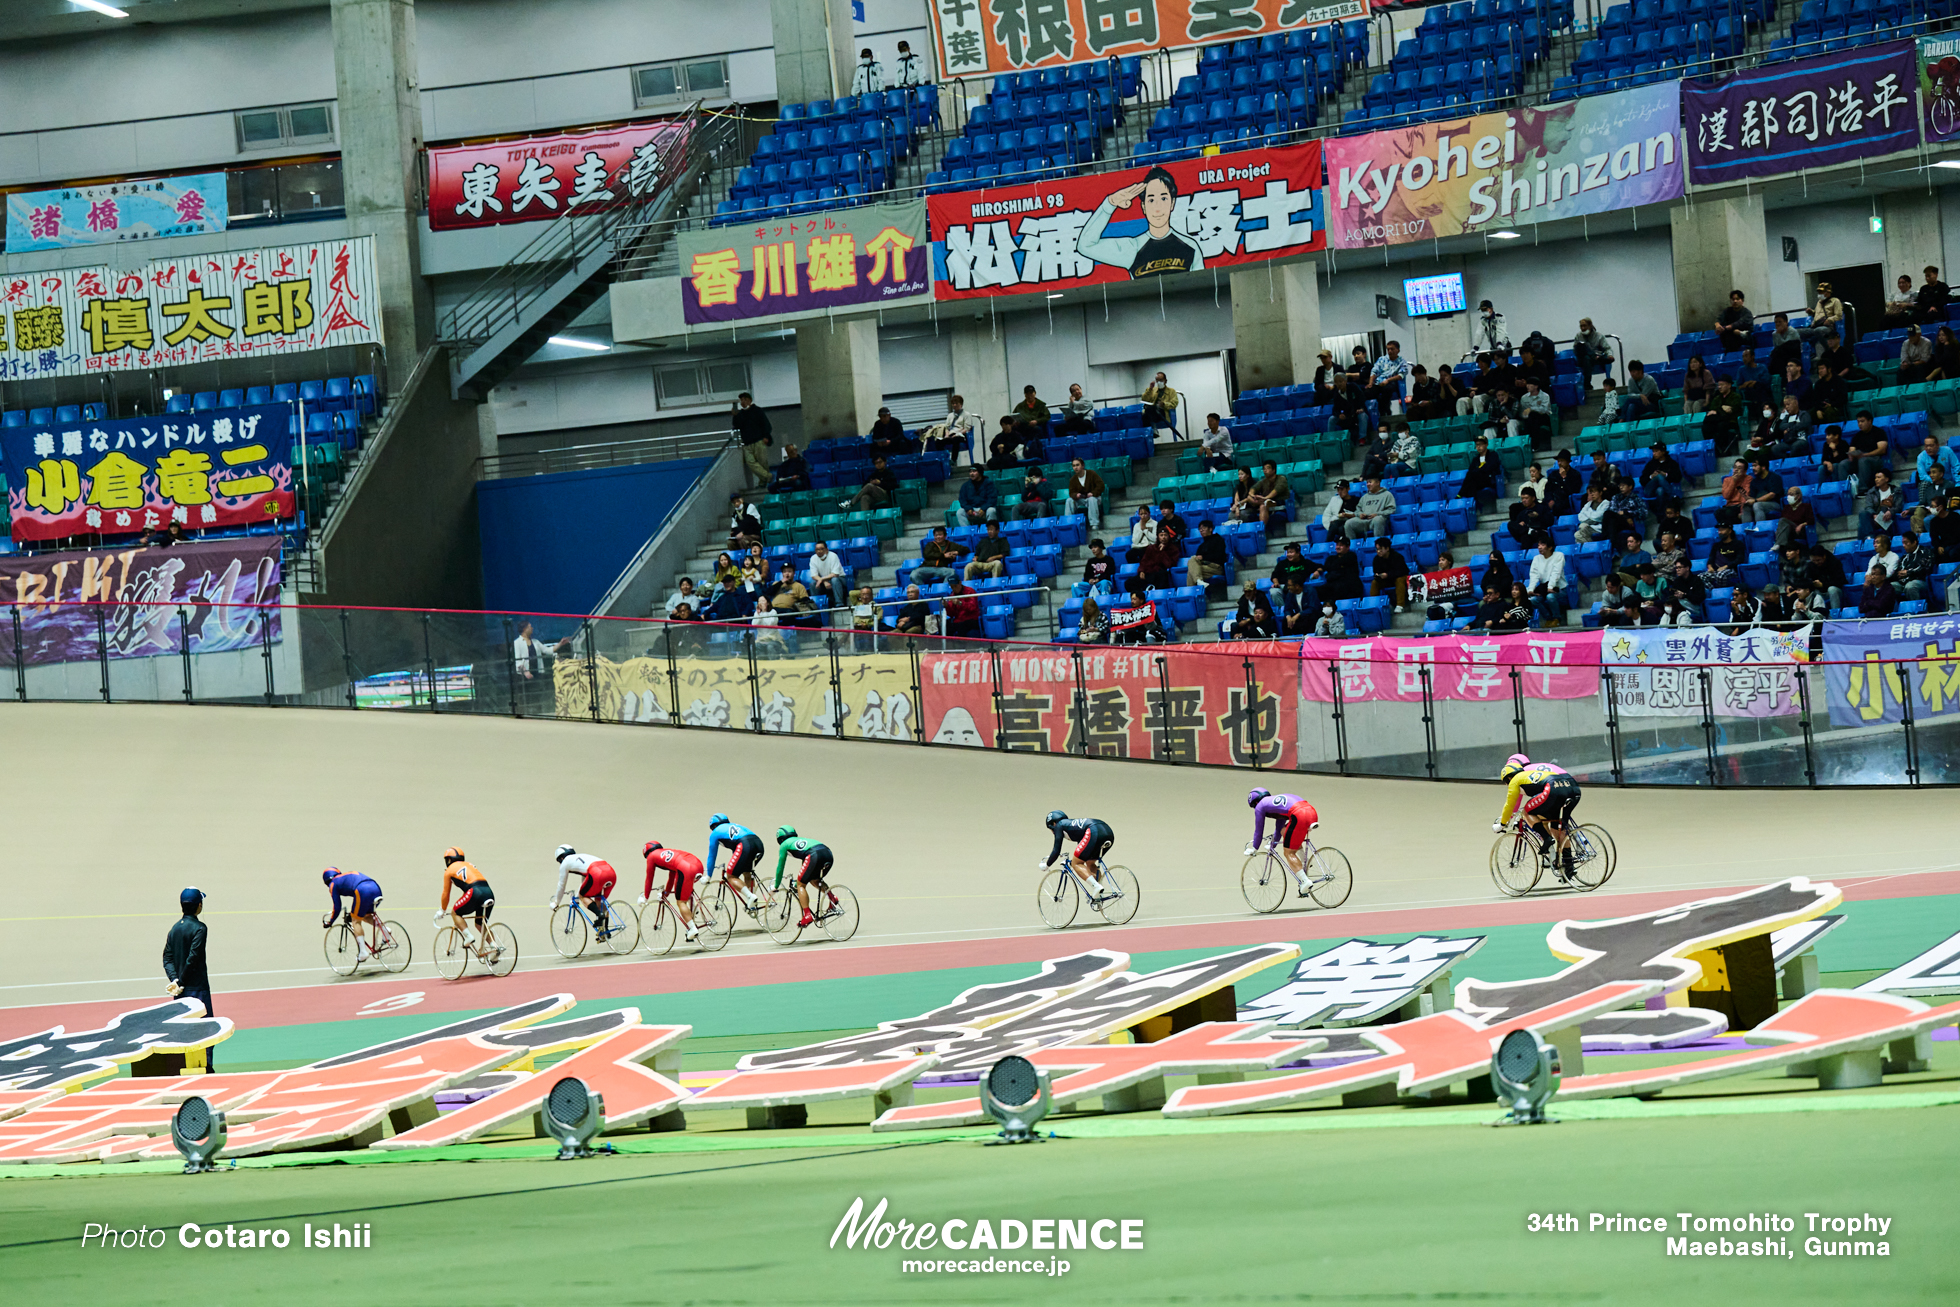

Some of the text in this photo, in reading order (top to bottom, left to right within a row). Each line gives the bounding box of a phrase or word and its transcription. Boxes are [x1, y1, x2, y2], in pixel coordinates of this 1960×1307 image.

[507, 148, 537, 162] TOYA
[540, 143, 578, 158] KEIGO
[1199, 162, 1271, 185] URA Project
[1338, 117, 1517, 214] Kyohei
[1467, 130, 1675, 225] Shinzan
[454, 142, 666, 219] 東矢圭吾
[29, 189, 206, 240] 諸橋愛
[972, 193, 1065, 218] HIROSHIMA 98
[1344, 219, 1425, 242] AOMORI 107
[691, 226, 915, 307] 香川雄介
[1145, 257, 1186, 271] KEIRIN
[0, 278, 314, 354] 藤慎太郎
[24, 444, 275, 515] 小倉竜二
[1890, 620, 1960, 640] 目指せテ
[1010, 655, 1105, 682] MONSTER
[1113, 653, 1163, 679] #115
[1338, 639, 1569, 698] 恩田淳平
[997, 682, 1282, 768] 高橋晋也
[729, 824, 741, 840] 4
[660, 850, 674, 862] 3
[795, 839, 808, 851] 6
[457, 866, 468, 881] 7
[355, 991, 426, 1016] 3
